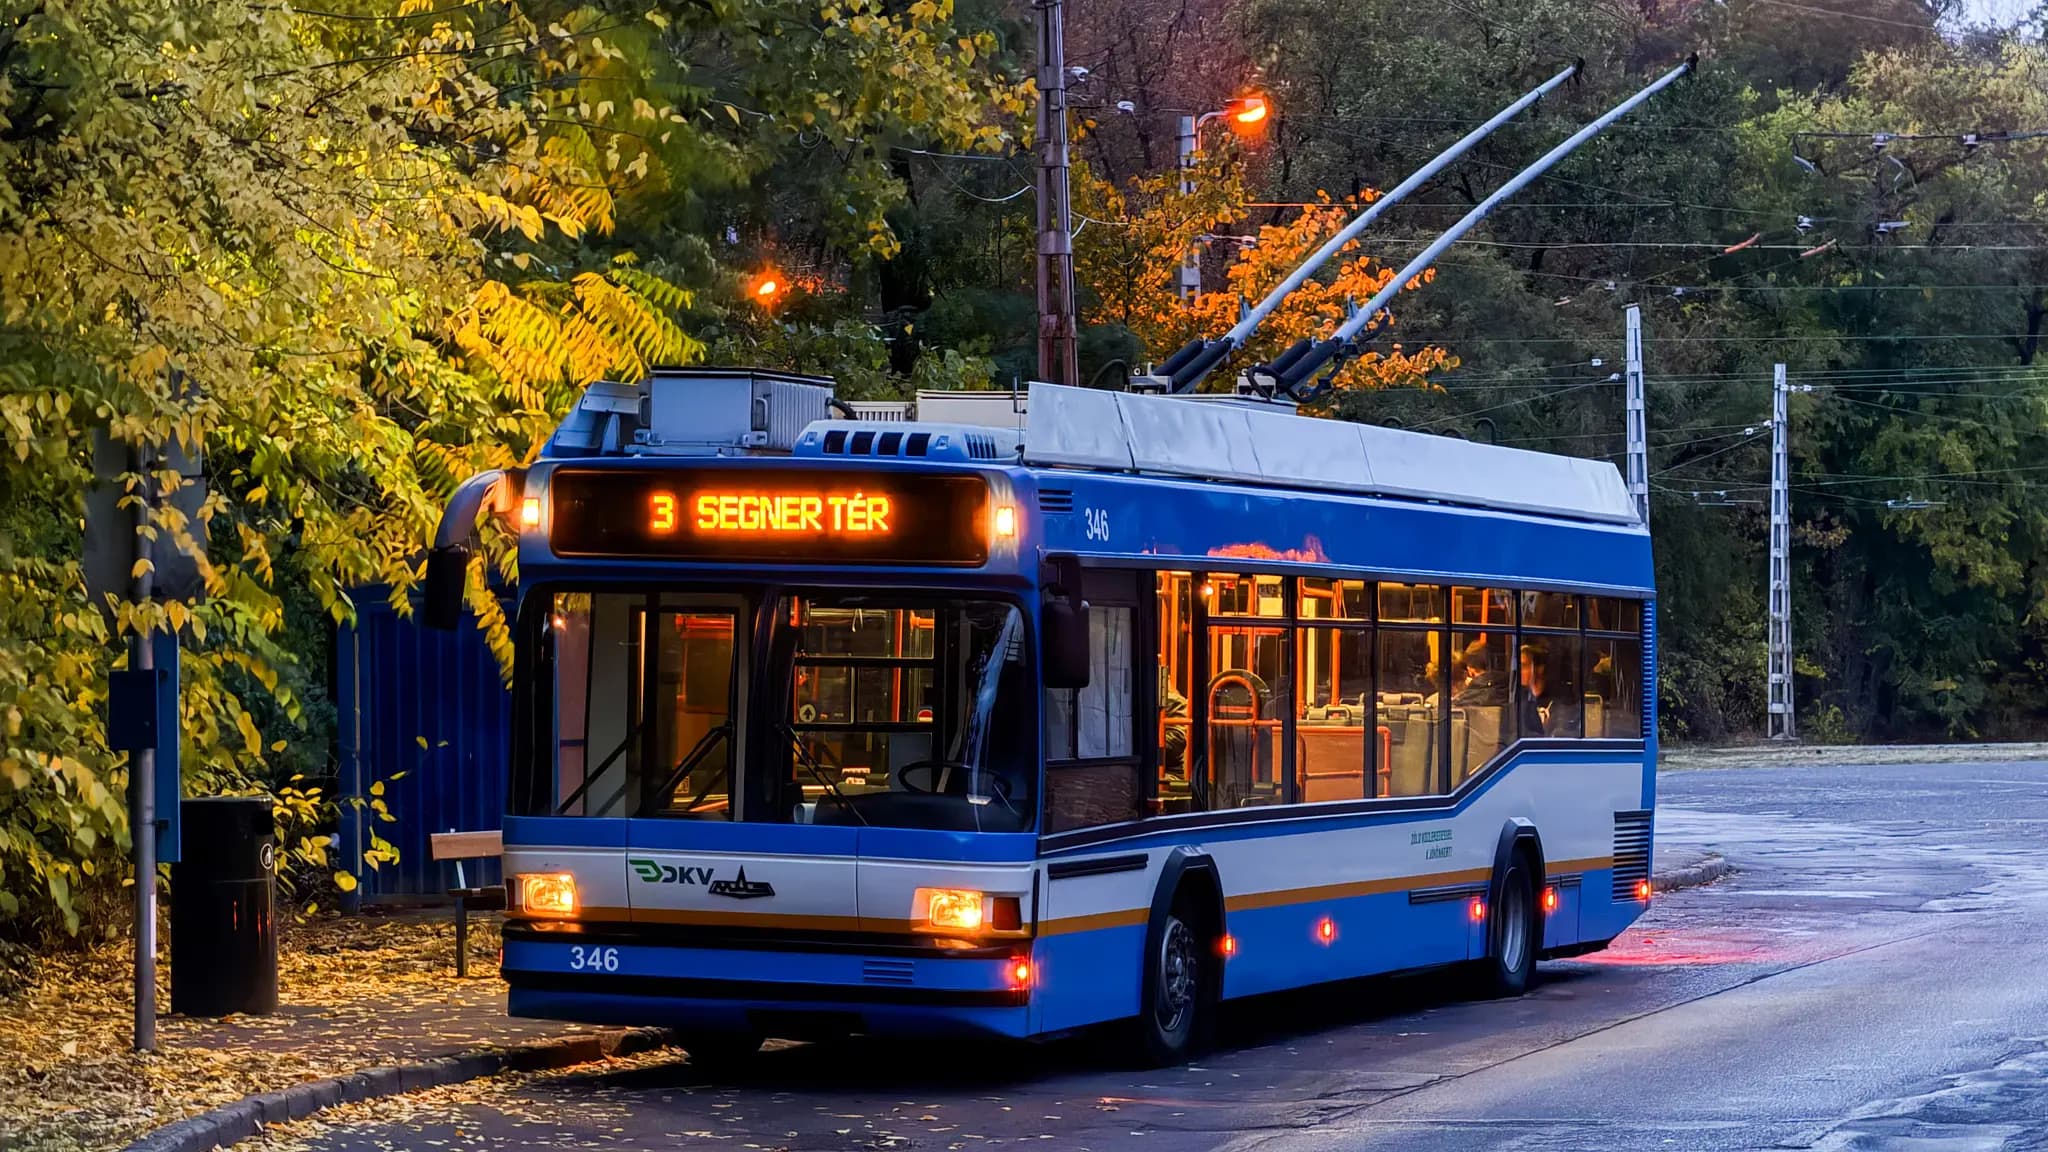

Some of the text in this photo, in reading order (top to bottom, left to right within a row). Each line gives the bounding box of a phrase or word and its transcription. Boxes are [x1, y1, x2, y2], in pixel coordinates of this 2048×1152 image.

[653, 492, 889, 531] 3 SEGNER TÉR
[1084, 507, 1110, 542] 346
[660, 864, 715, 886] DKV
[570, 945, 619, 972] 346
